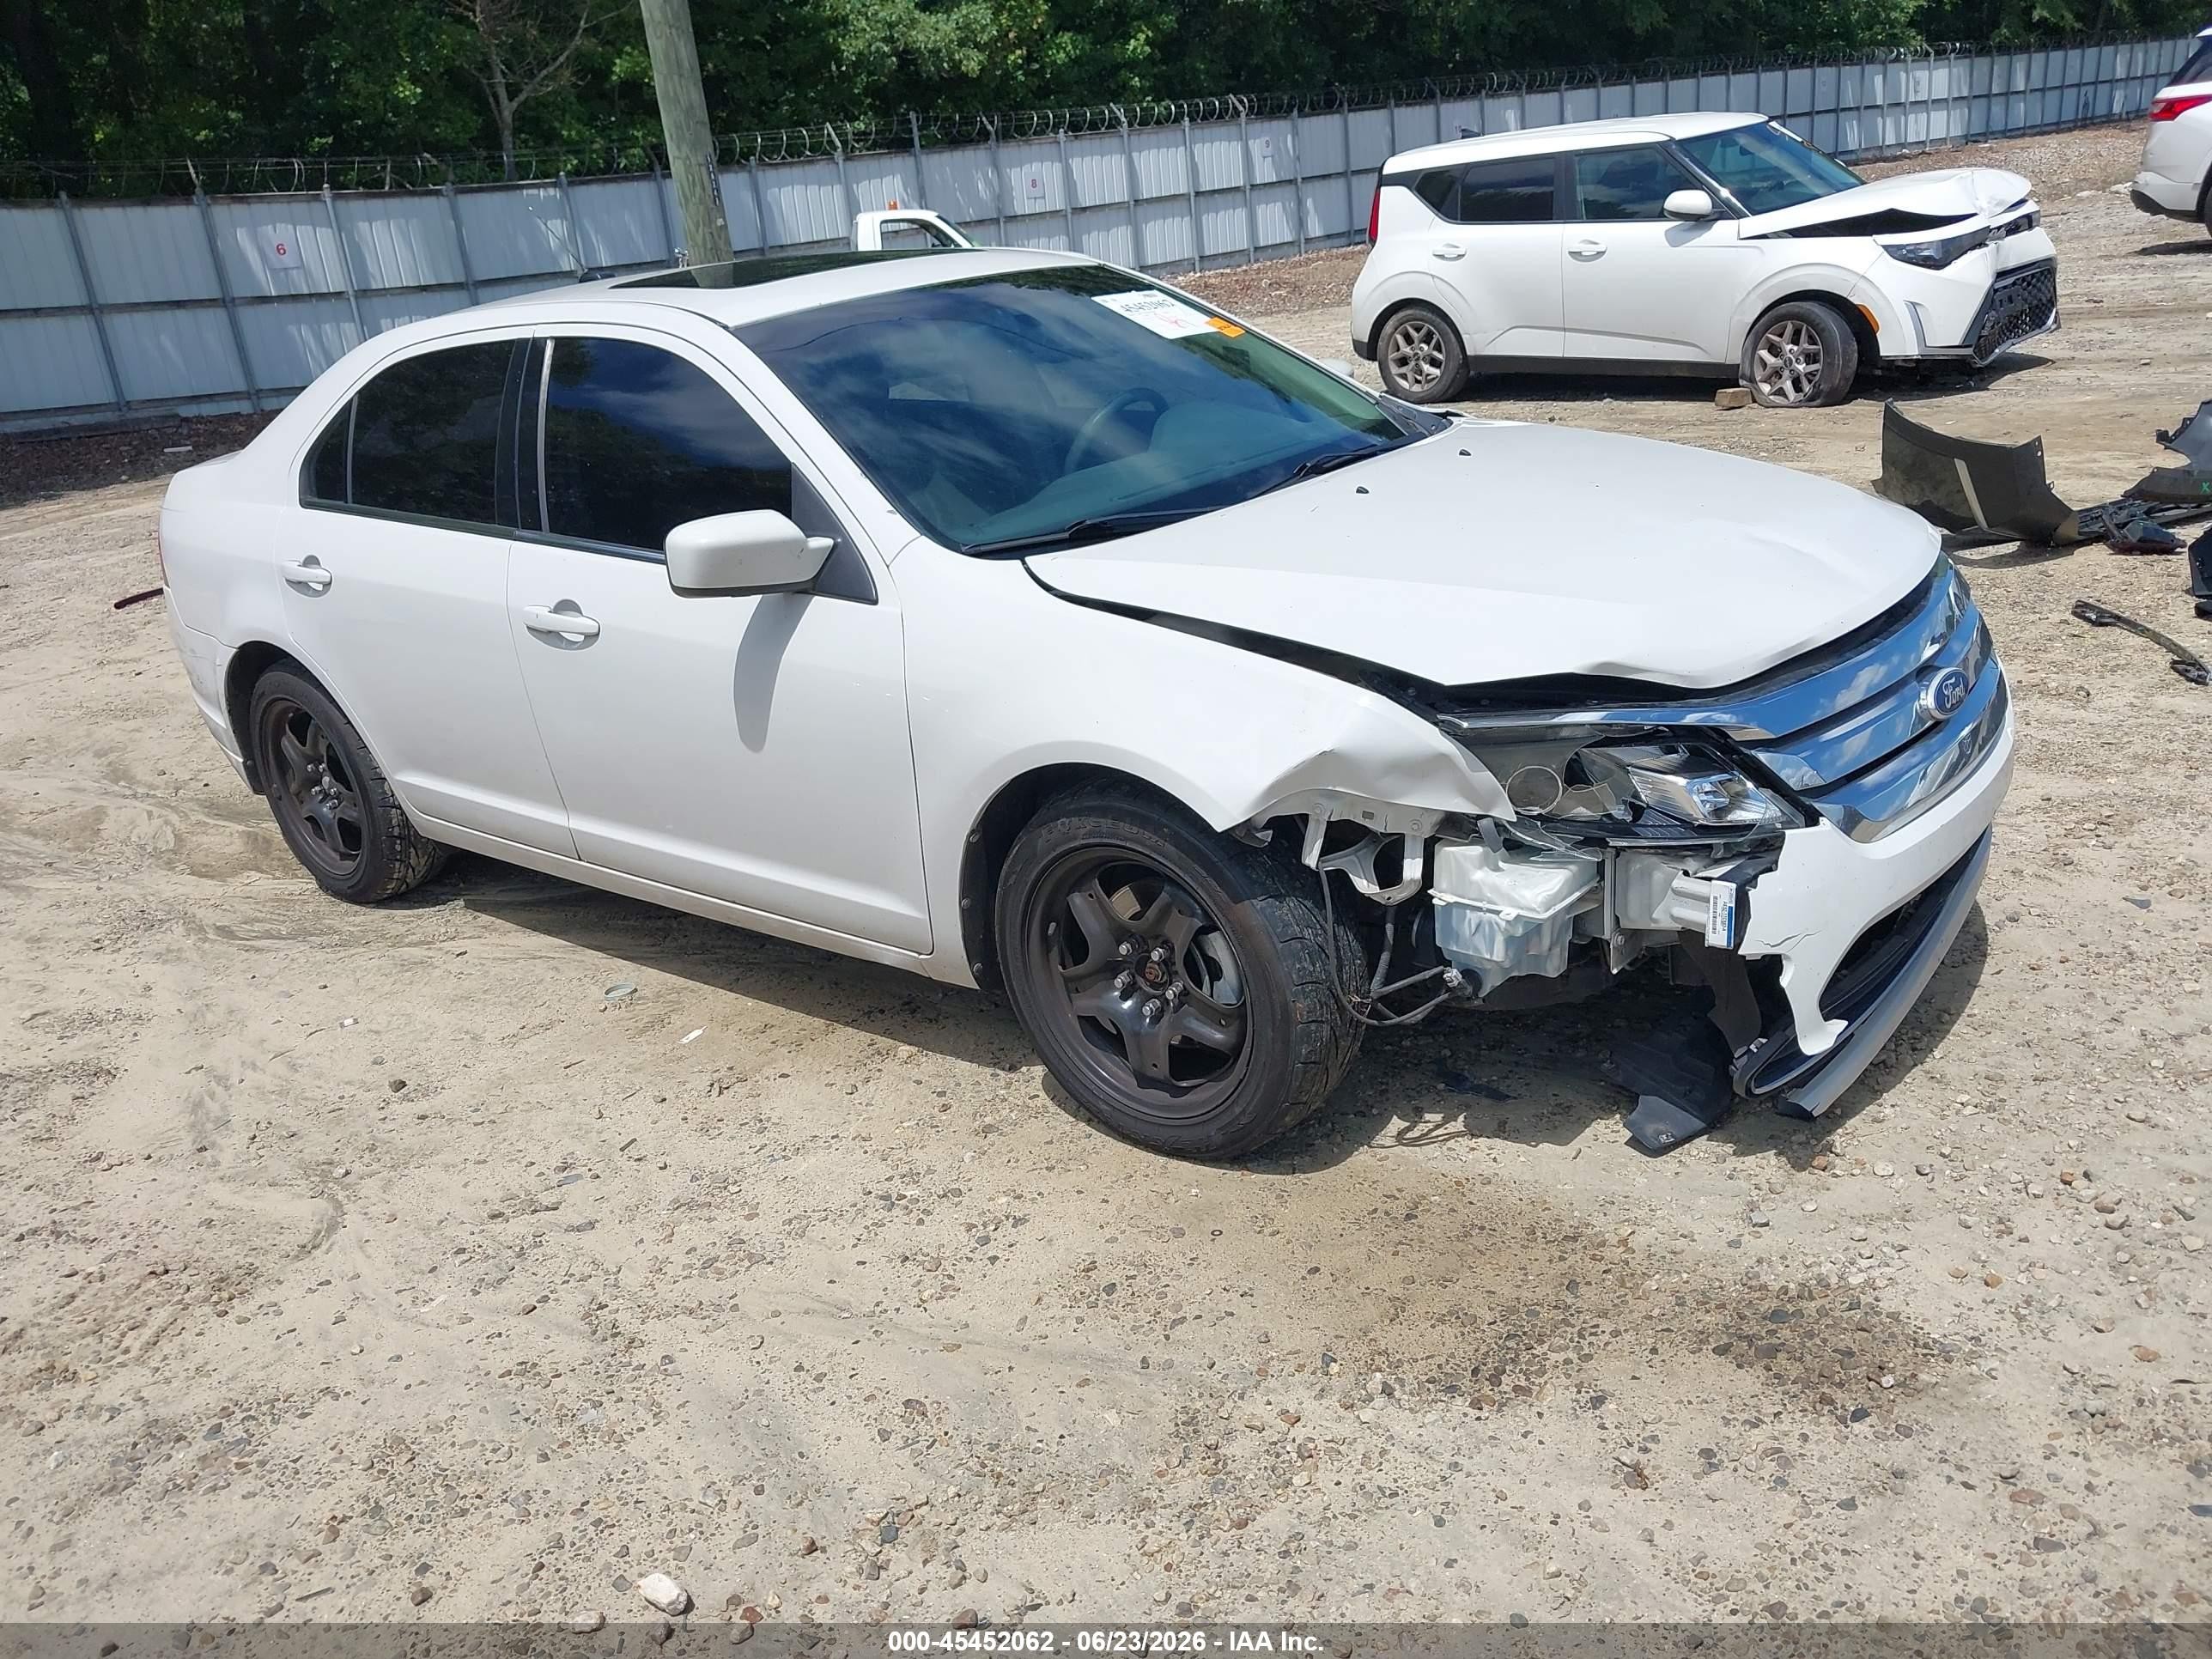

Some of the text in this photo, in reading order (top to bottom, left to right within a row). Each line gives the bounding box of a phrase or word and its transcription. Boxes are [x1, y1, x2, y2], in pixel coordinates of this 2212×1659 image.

[1031, 179, 1037, 188] 8
[276, 243, 287, 255] 6
[1942, 676, 1966, 708] Ford
